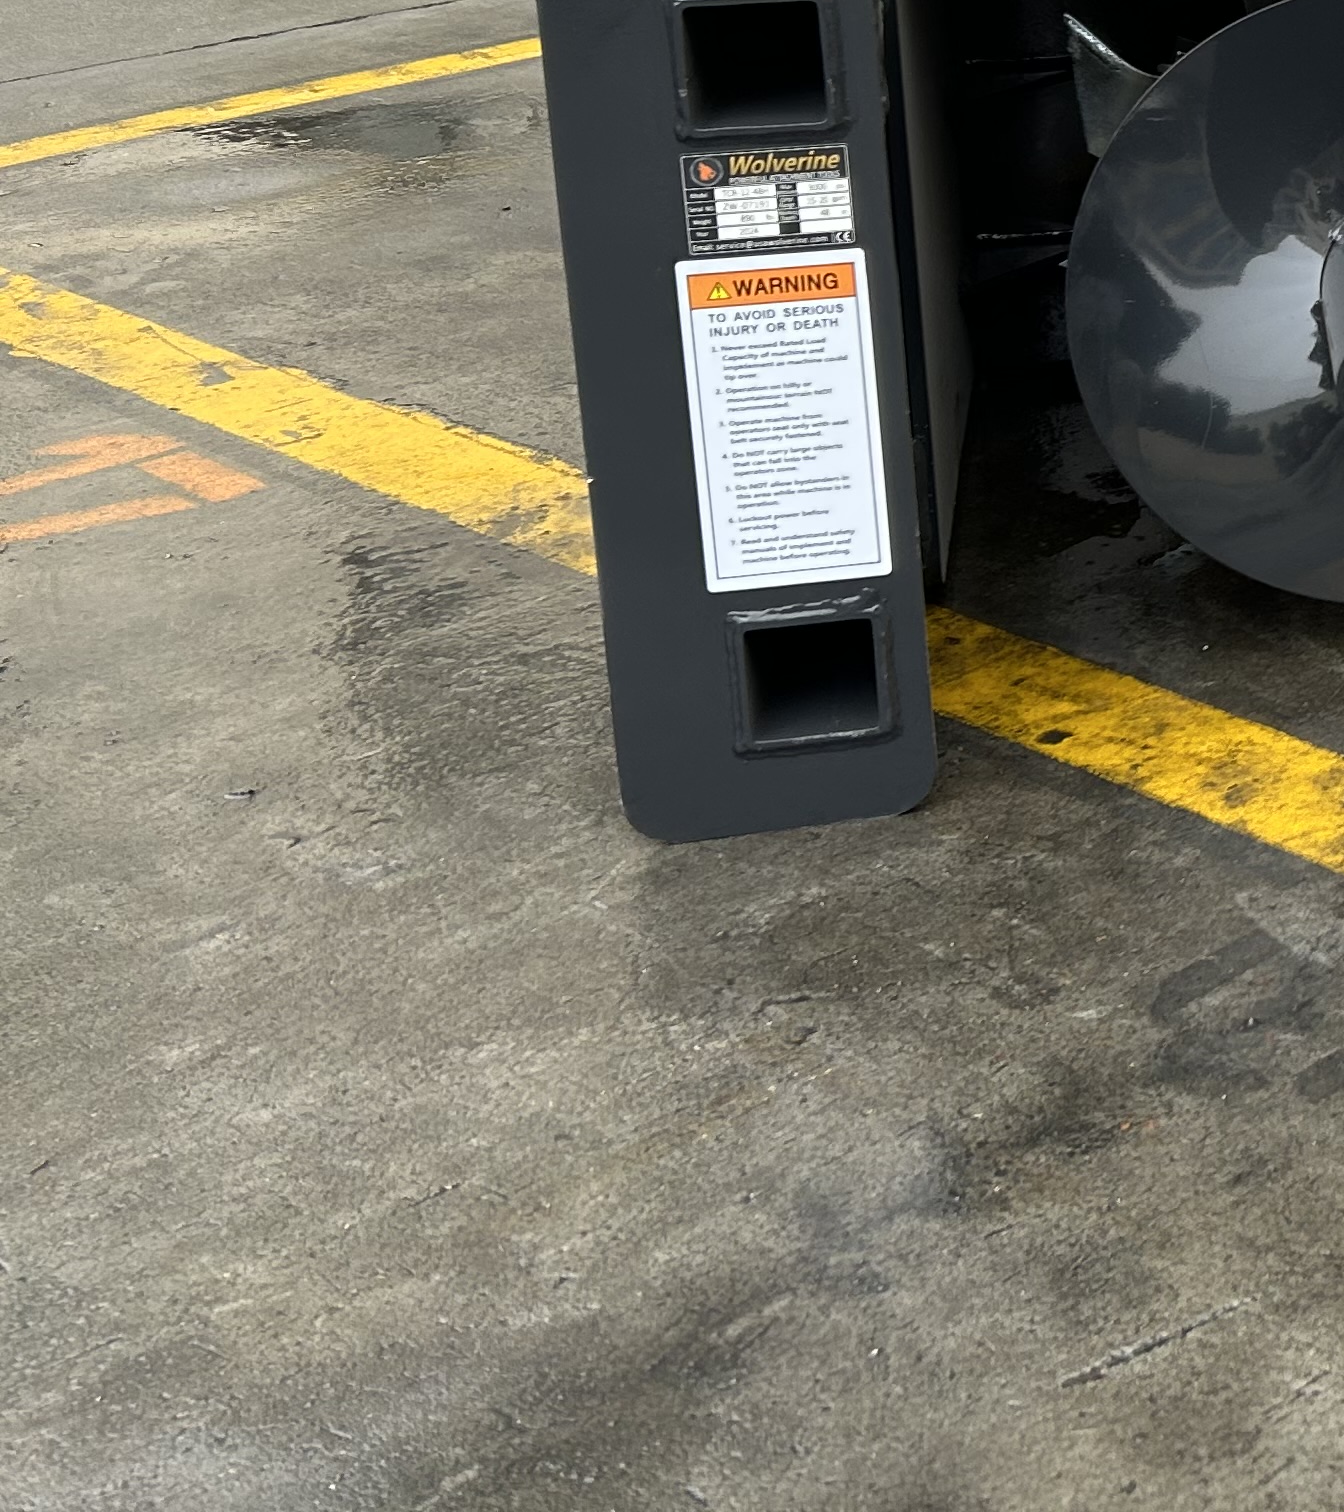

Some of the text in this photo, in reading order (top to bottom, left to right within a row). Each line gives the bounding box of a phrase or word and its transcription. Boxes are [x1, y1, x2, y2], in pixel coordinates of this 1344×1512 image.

[728, 150, 841, 176] Wolverine
[732, 272, 839, 297] WARNING
[708, 303, 845, 324] TO AVOID SERIOUS
[708, 317, 840, 338] INJURY OR DEATH
